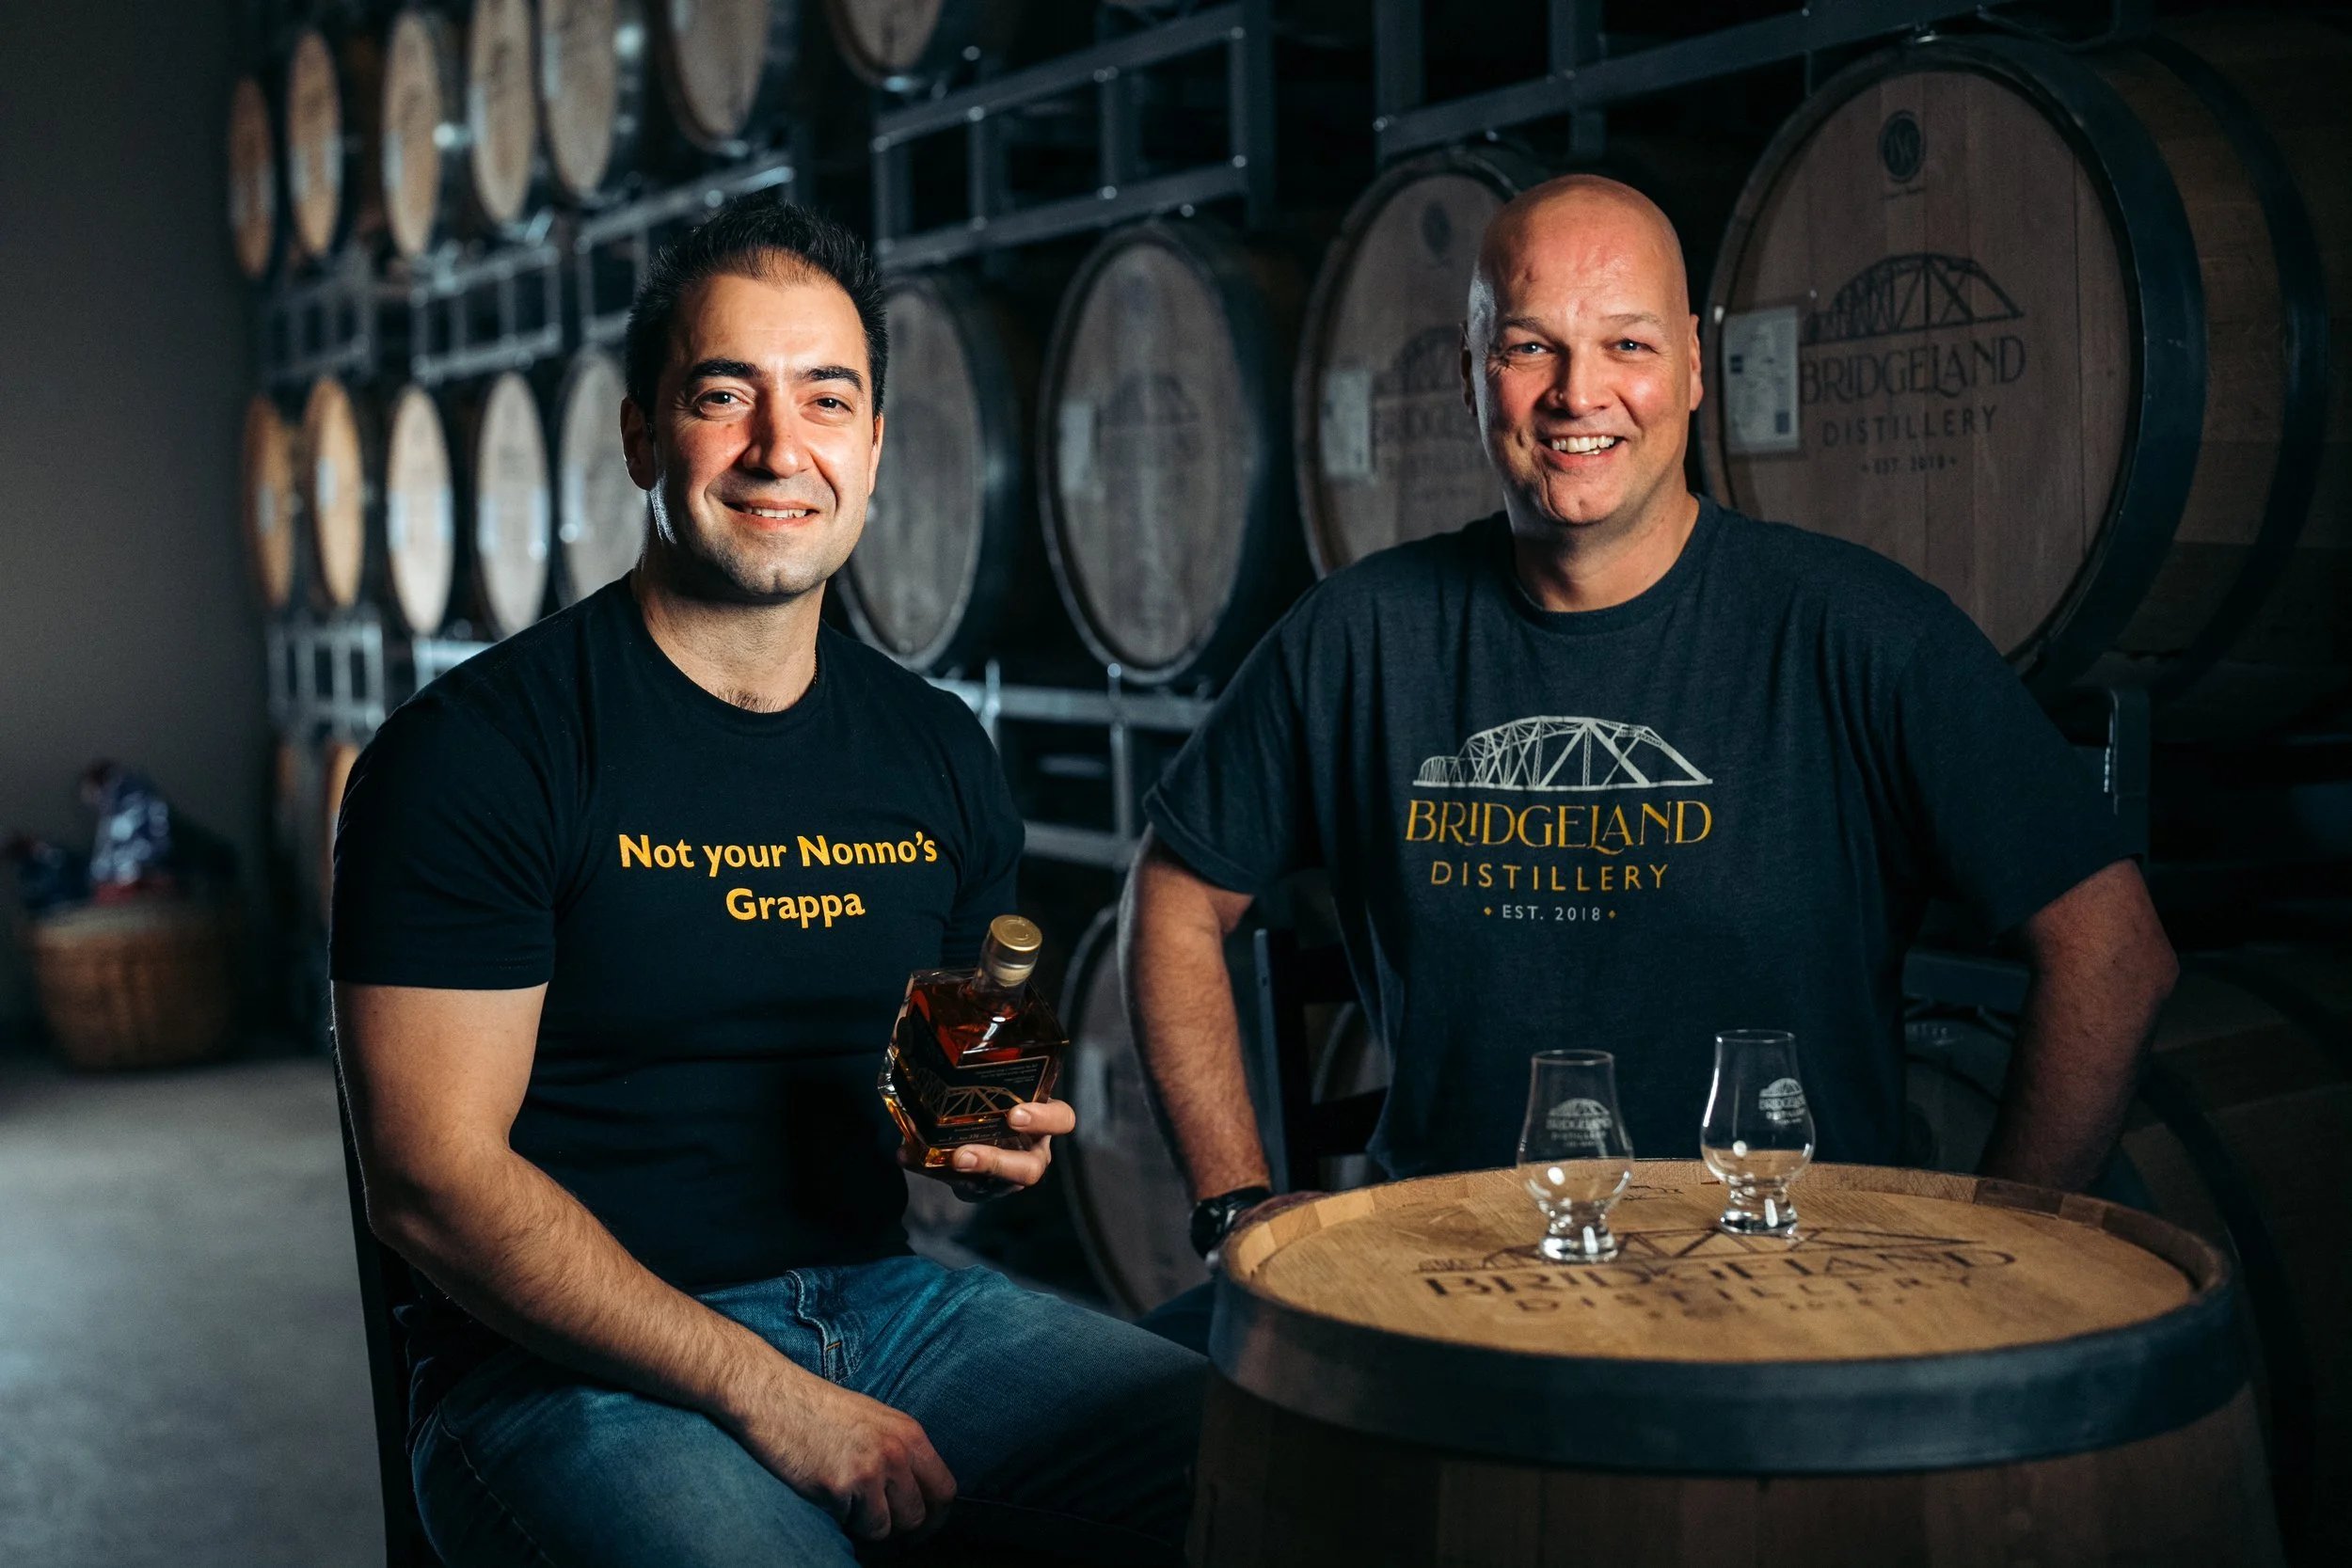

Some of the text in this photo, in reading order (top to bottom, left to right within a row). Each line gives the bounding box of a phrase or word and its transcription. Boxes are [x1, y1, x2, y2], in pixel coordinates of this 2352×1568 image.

[1800, 335, 2026, 404] BRIDGELAND
[1821, 404, 1997, 447] DISTILLERY
[1406, 800, 1713, 855] BRIDGELAND
[617, 831, 939, 879] Not your Nonno’s
[1430, 860, 1668, 892] DISTILLERY
[724, 887, 866, 929] Grappa
[1502, 905, 1600, 922] EST. 2018
